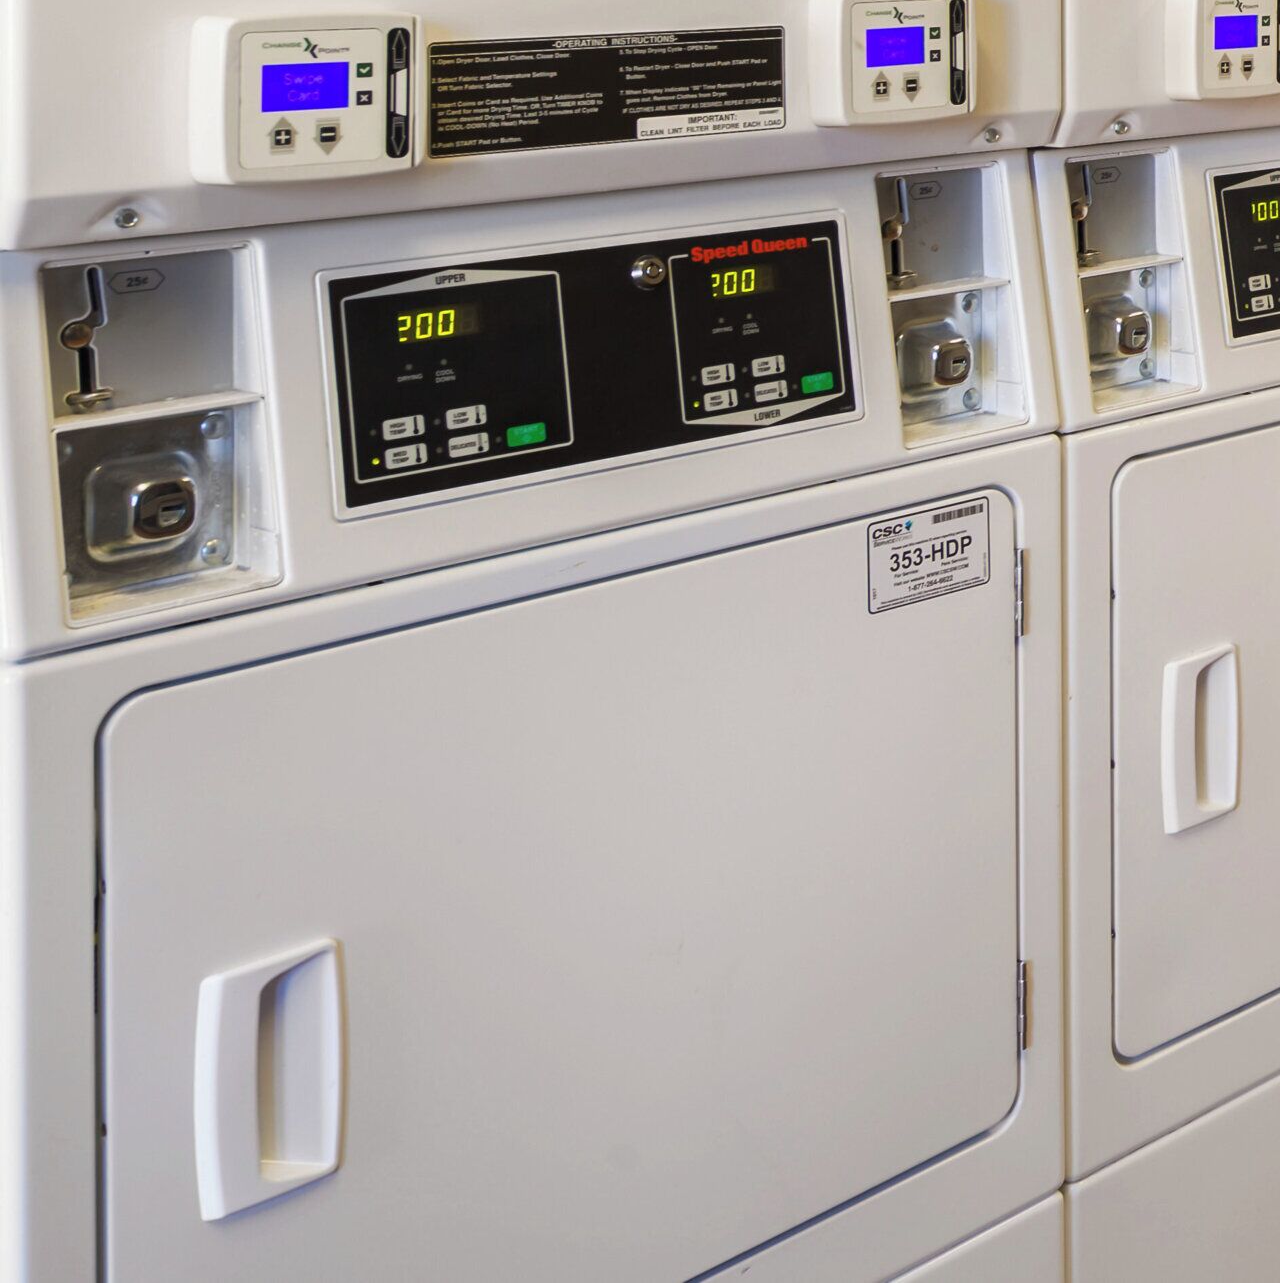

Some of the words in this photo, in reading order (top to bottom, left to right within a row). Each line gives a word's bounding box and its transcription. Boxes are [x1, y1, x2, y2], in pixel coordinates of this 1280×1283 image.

[287, 90, 320, 102] Card
[640, 129, 665, 137] CLEAN
[686, 125, 709, 133] FILTER
[742, 120, 762, 128] EACH
[764, 118, 782, 126] LOAD
[691, 241, 748, 263] Speed
[751, 236, 807, 253] Queen
[435, 273, 466, 286] UPPER
[754, 409, 781, 422] LOWER
[872, 523, 904, 540] CSC
[890, 535, 972, 572] 353-HDP
